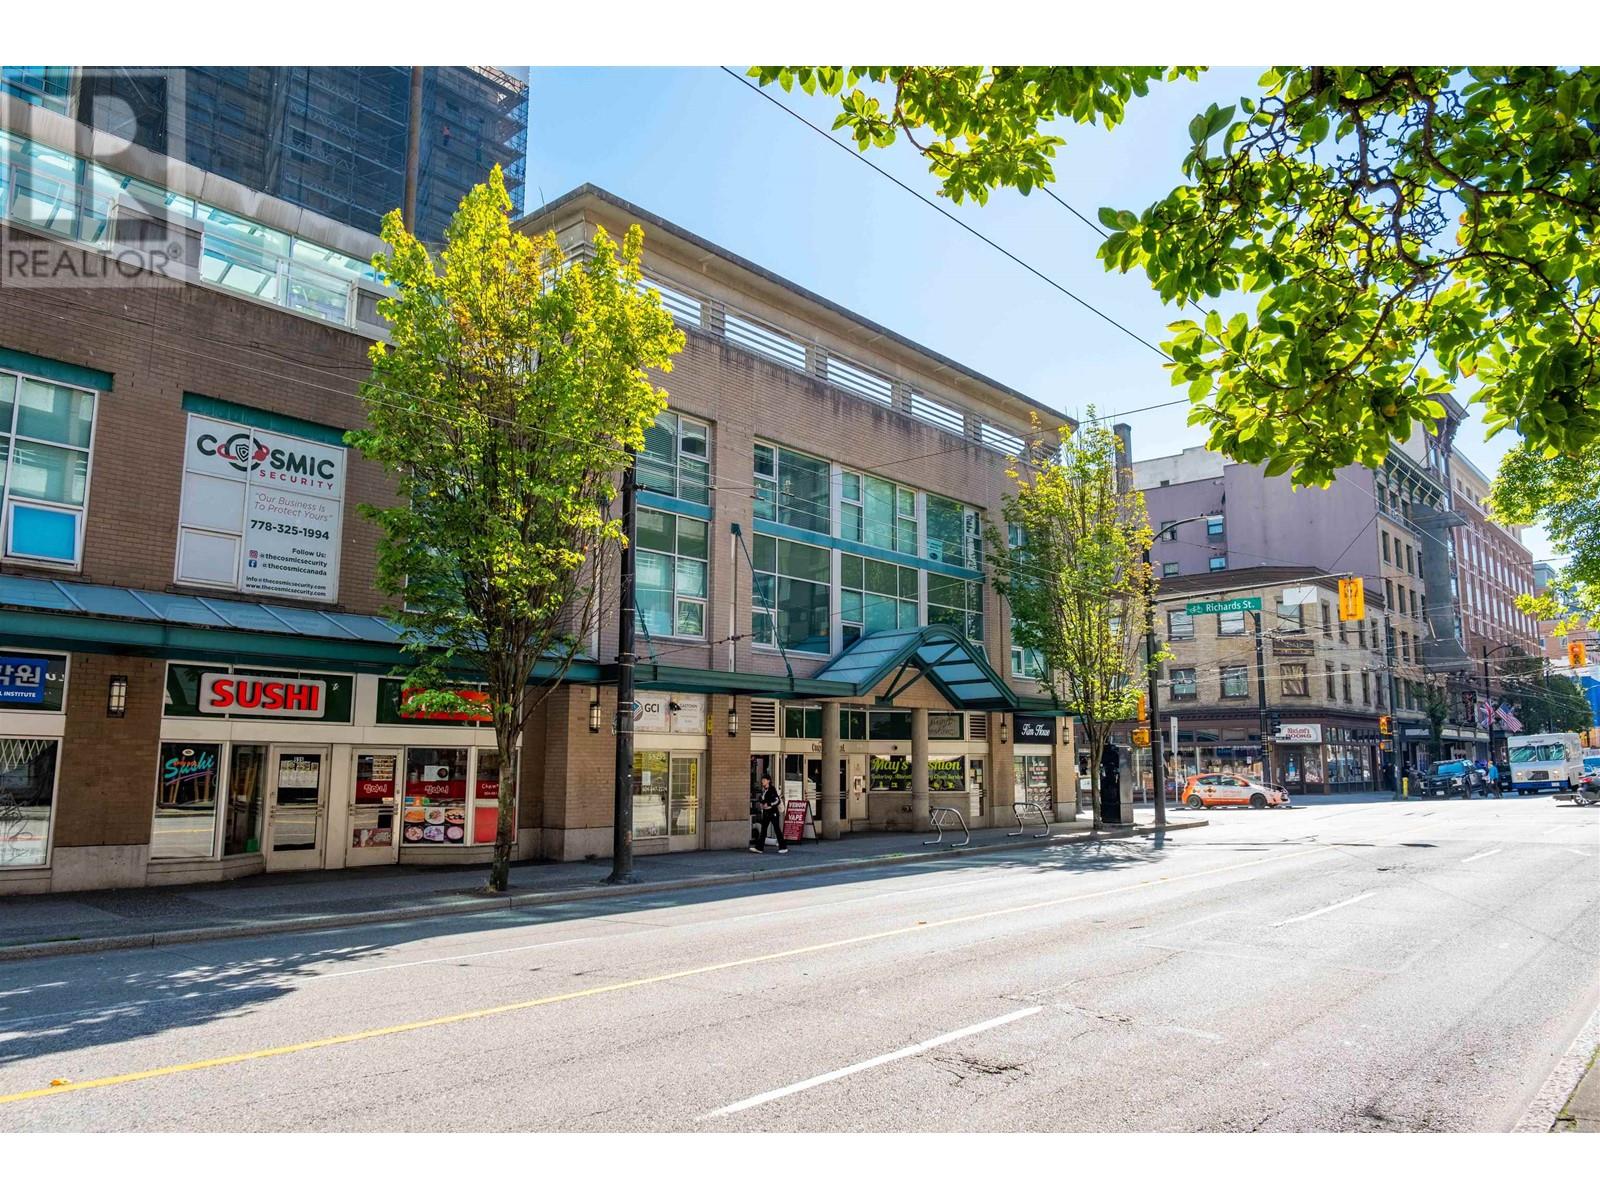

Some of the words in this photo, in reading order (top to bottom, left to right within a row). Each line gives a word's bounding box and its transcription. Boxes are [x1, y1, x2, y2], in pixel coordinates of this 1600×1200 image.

[197, 433, 335, 479] COSMIC
[259, 469, 334, 490] SECURITY
[255, 501, 266, 510] To
[268, 504, 302, 517] Protect
[278, 496, 316, 511] Business
[251, 519, 330, 540] 778-325-1994
[292, 548, 314, 556] Follow
[1206, 602, 1241, 612] Richards
[1243, 600, 1255, 609] St.
[210, 679, 319, 711] SUSHI
[644, 703, 660, 713] GCI
[164, 752, 214, 779] Sushi
